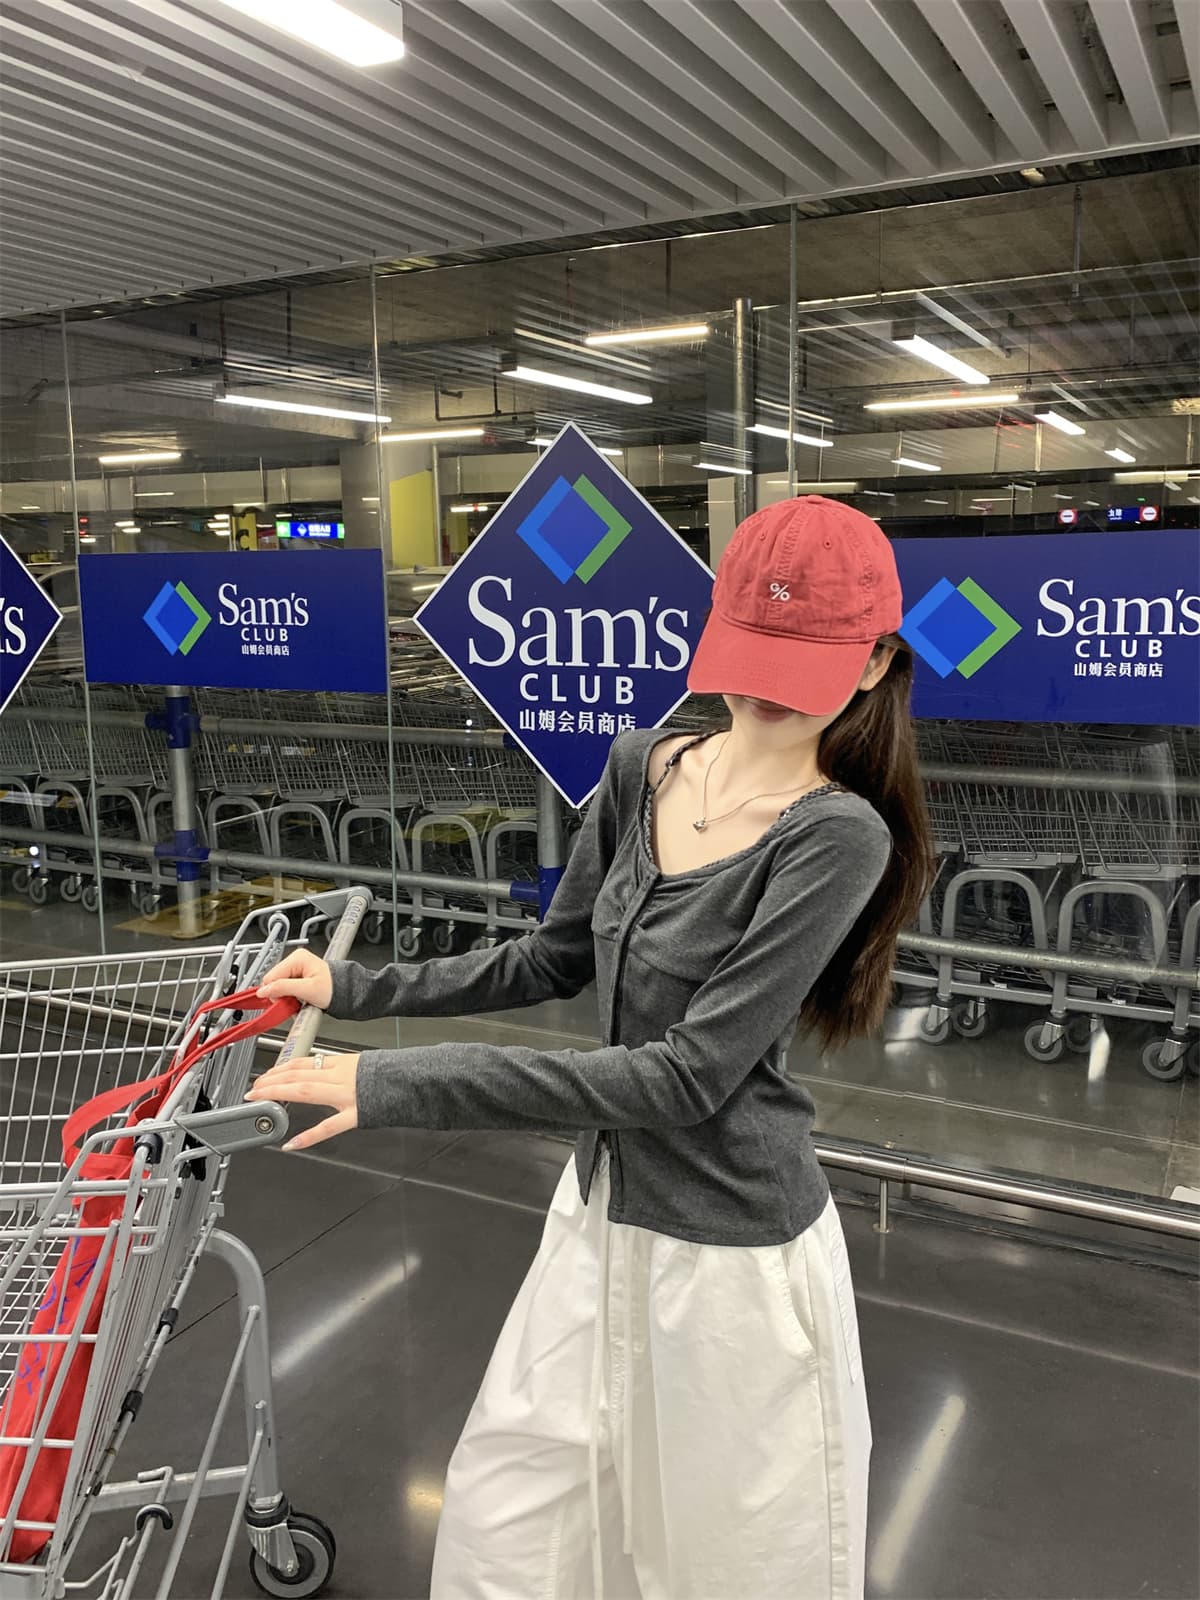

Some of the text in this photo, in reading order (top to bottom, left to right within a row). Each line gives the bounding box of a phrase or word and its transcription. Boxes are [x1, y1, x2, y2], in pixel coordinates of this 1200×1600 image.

[218, 583, 309, 630] Sam's
[1037, 578, 1200, 637] Sam's
[241, 628, 289, 642] CLUB
[467, 575, 691, 672] Sam's
[1075, 639, 1164, 658] CLUB
[1074, 662, 1164, 678] 山姆会员商店
[519, 673, 635, 705] CLUB
